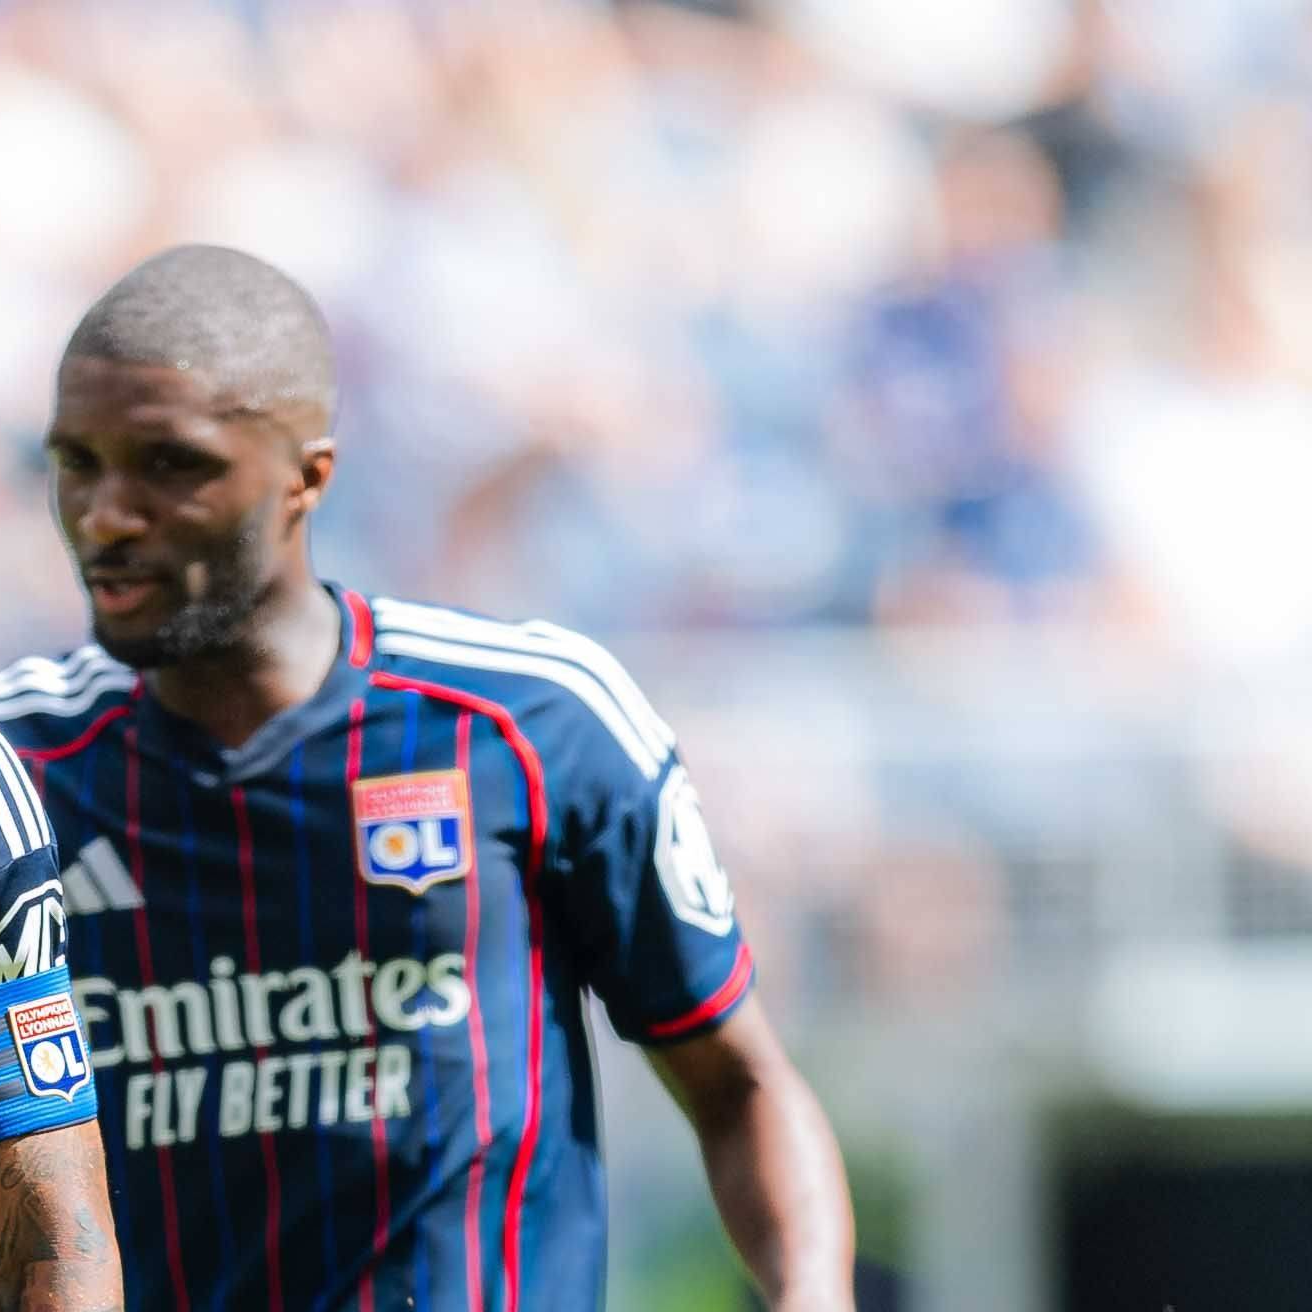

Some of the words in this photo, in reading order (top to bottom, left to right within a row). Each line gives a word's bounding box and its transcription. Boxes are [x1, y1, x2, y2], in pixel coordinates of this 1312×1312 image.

[73, 949, 472, 1068] Emirates
[125, 1067, 208, 1151] FLY
[219, 1044, 412, 1139] BETTER
